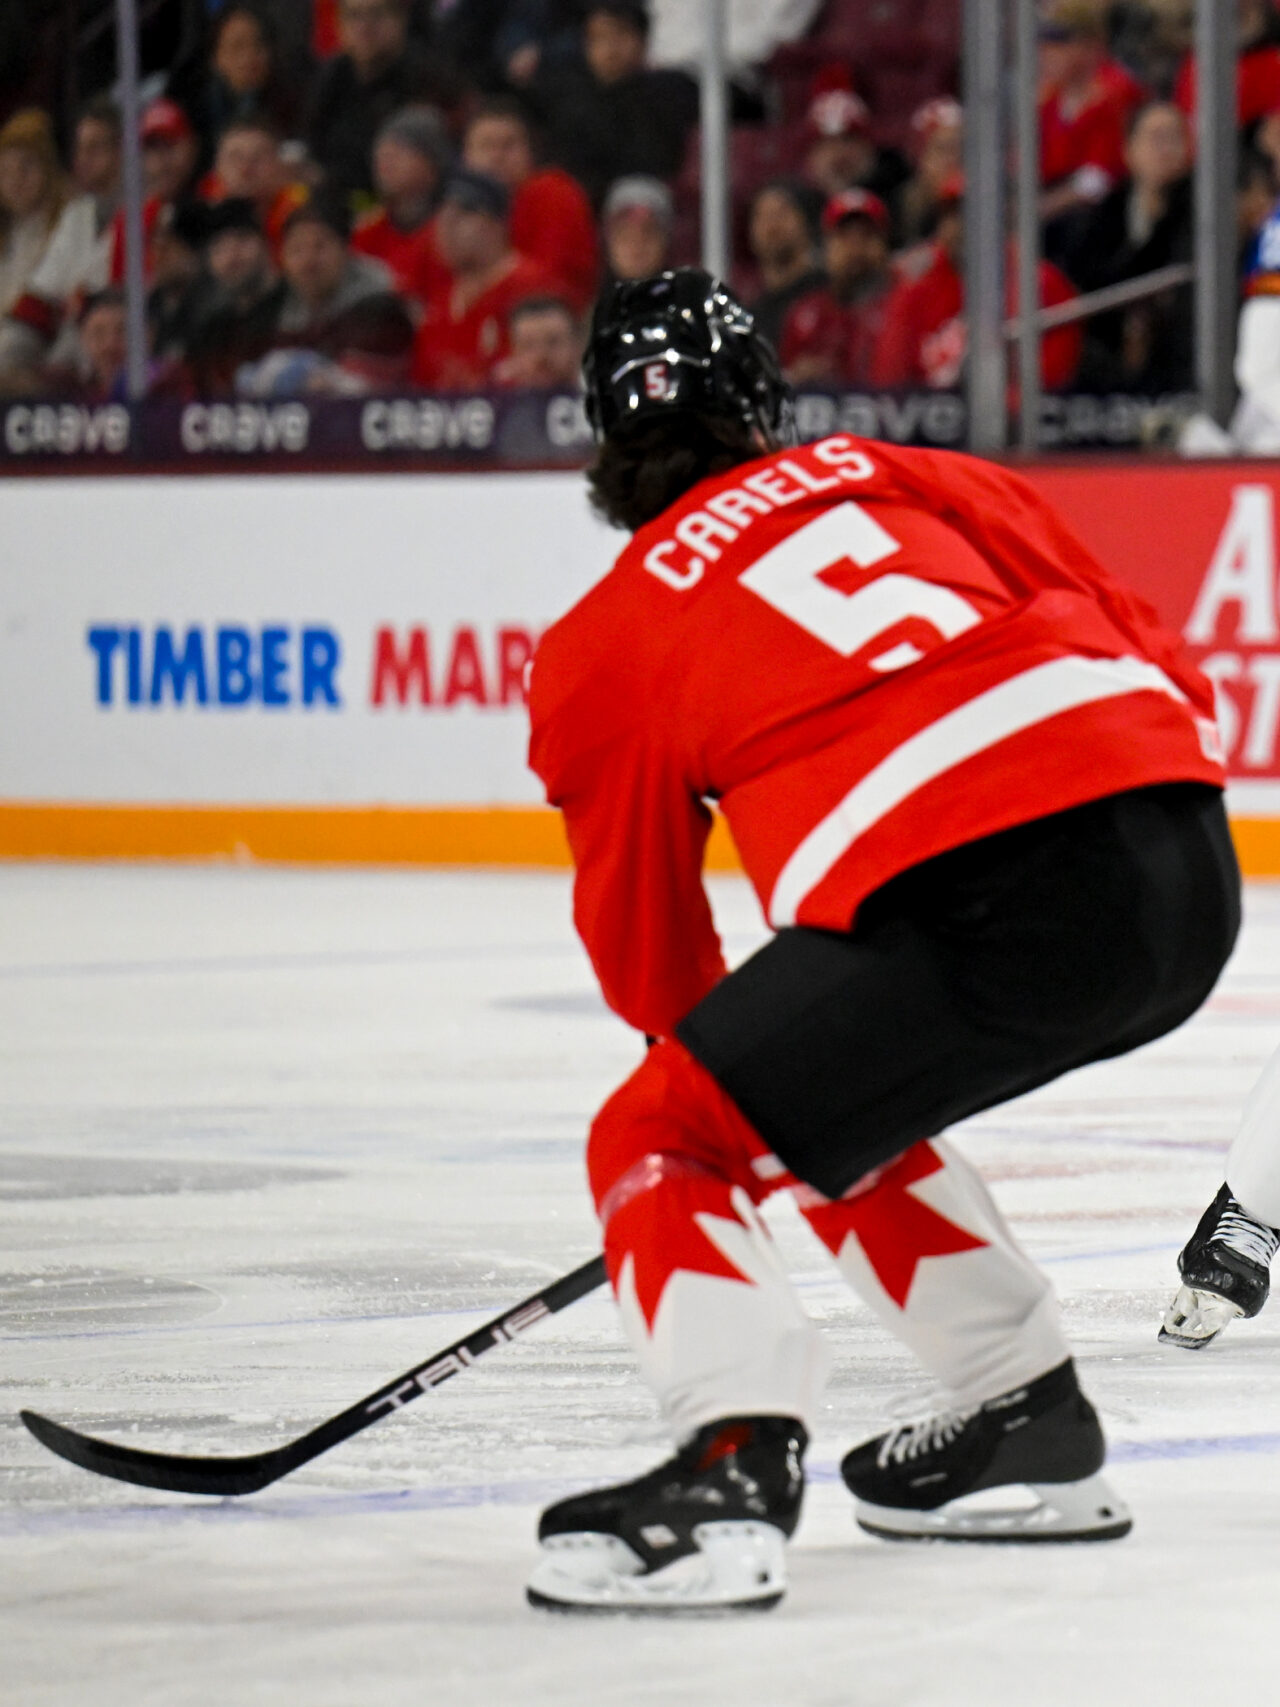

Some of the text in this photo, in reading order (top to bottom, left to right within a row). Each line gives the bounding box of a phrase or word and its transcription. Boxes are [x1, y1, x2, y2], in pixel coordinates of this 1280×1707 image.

[644, 365, 668, 399] 5
[643, 437, 875, 592] CARELS
[738, 500, 983, 672] 5
[87, 624, 545, 707] TIMBER MAR
